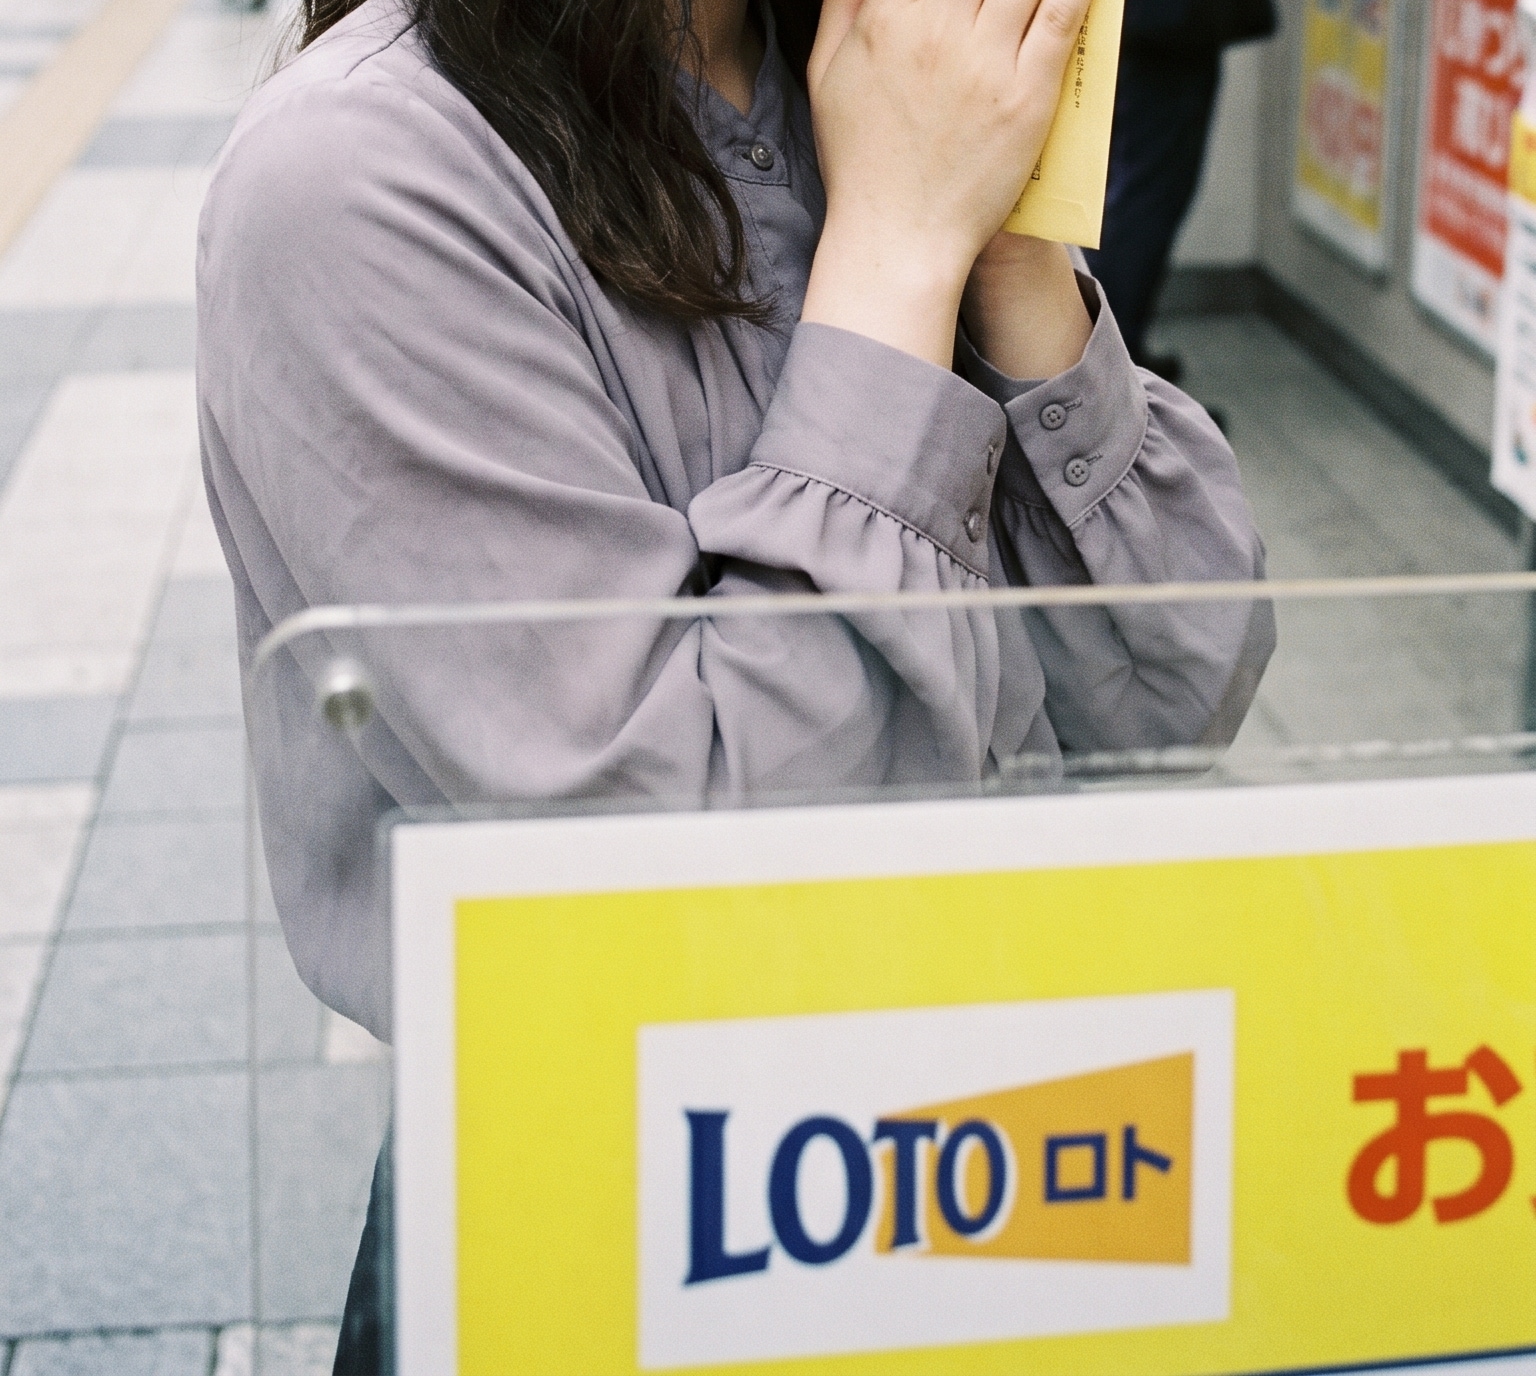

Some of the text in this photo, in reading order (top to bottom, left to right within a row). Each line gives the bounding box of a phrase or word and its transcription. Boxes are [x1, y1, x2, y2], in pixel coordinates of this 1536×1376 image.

[683, 1108, 1173, 1287] LOTO ロト
[1346, 1043, 1536, 1225] お
